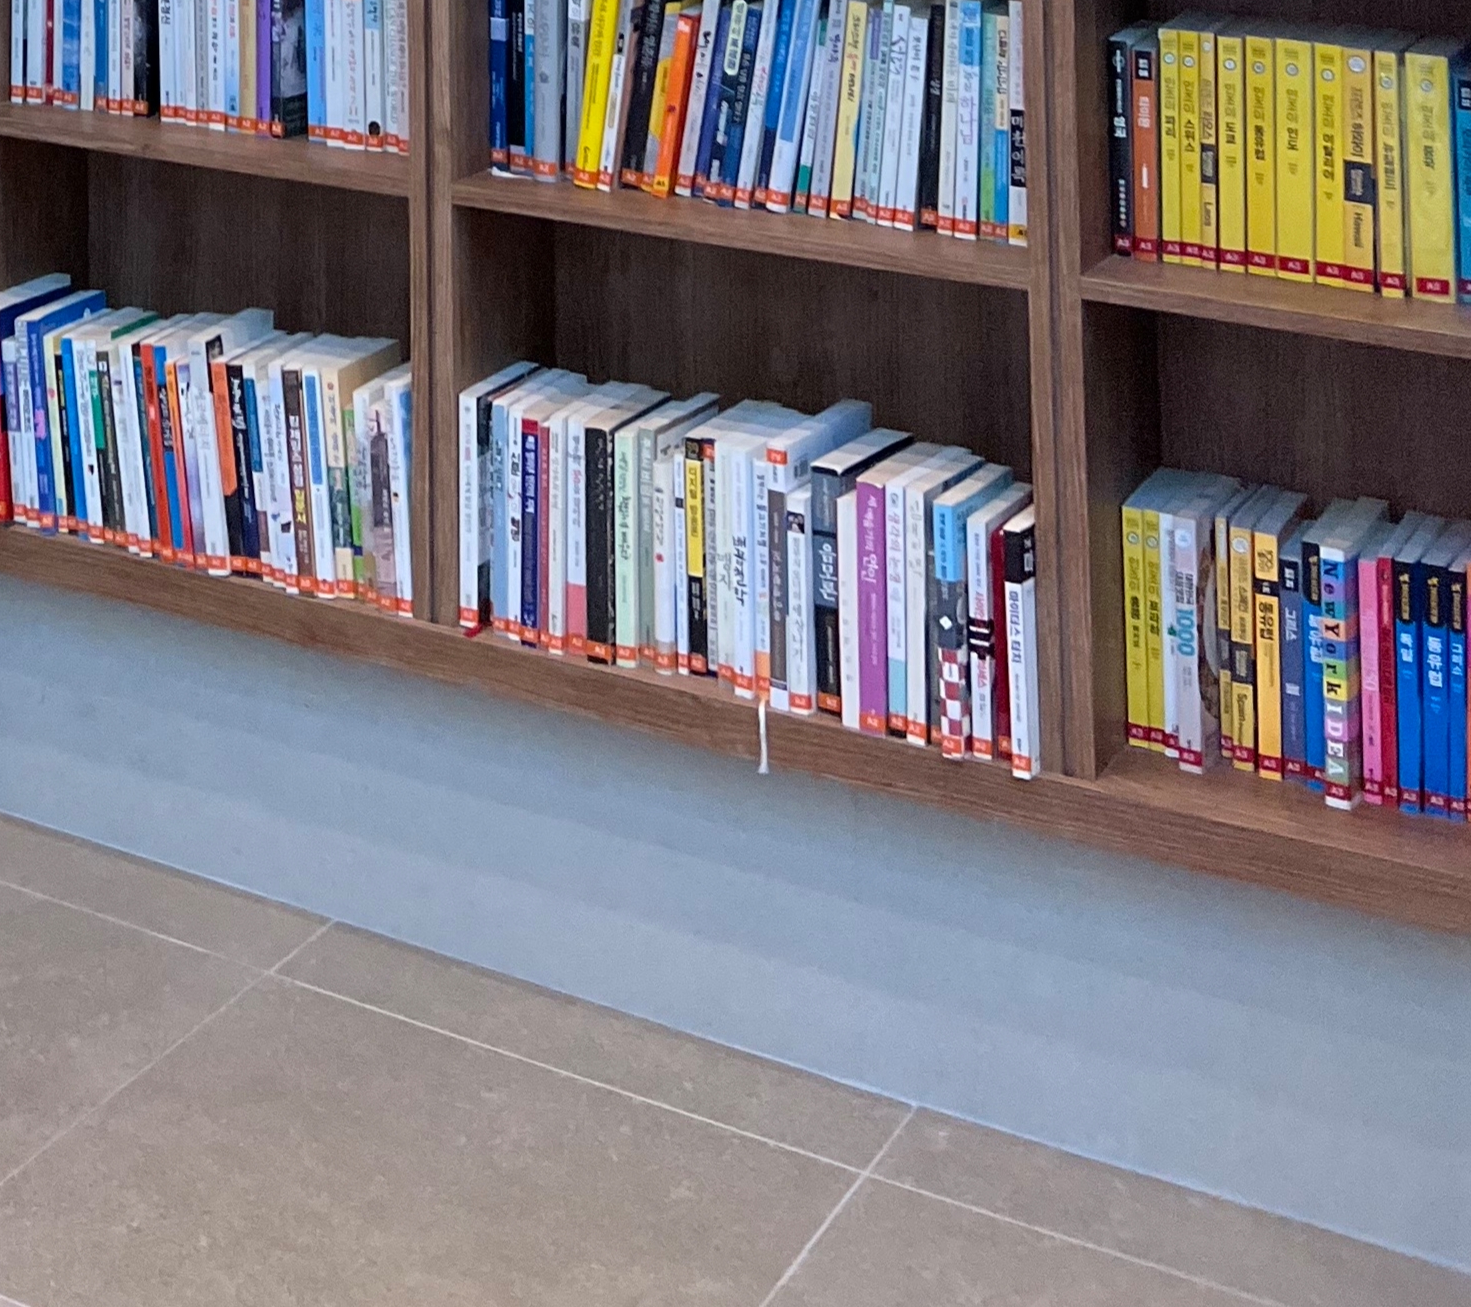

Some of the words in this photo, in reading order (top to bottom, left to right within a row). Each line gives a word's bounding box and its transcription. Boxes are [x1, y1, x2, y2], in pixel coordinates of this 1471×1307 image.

[1349, 122, 1363, 157] 하와이
[1204, 202, 1212, 226] Laos
[1353, 210, 1363, 248] Hawaii
[1322, 560, 1340, 619] New
[1177, 608, 1195, 657] 1000
[1259, 601, 1274, 640] 동유럽
[1011, 641, 1021, 664] 터치
[1325, 622, 1342, 696] York
[1237, 693, 1247, 722] Spain
[1325, 703, 1344, 776] IDEA
